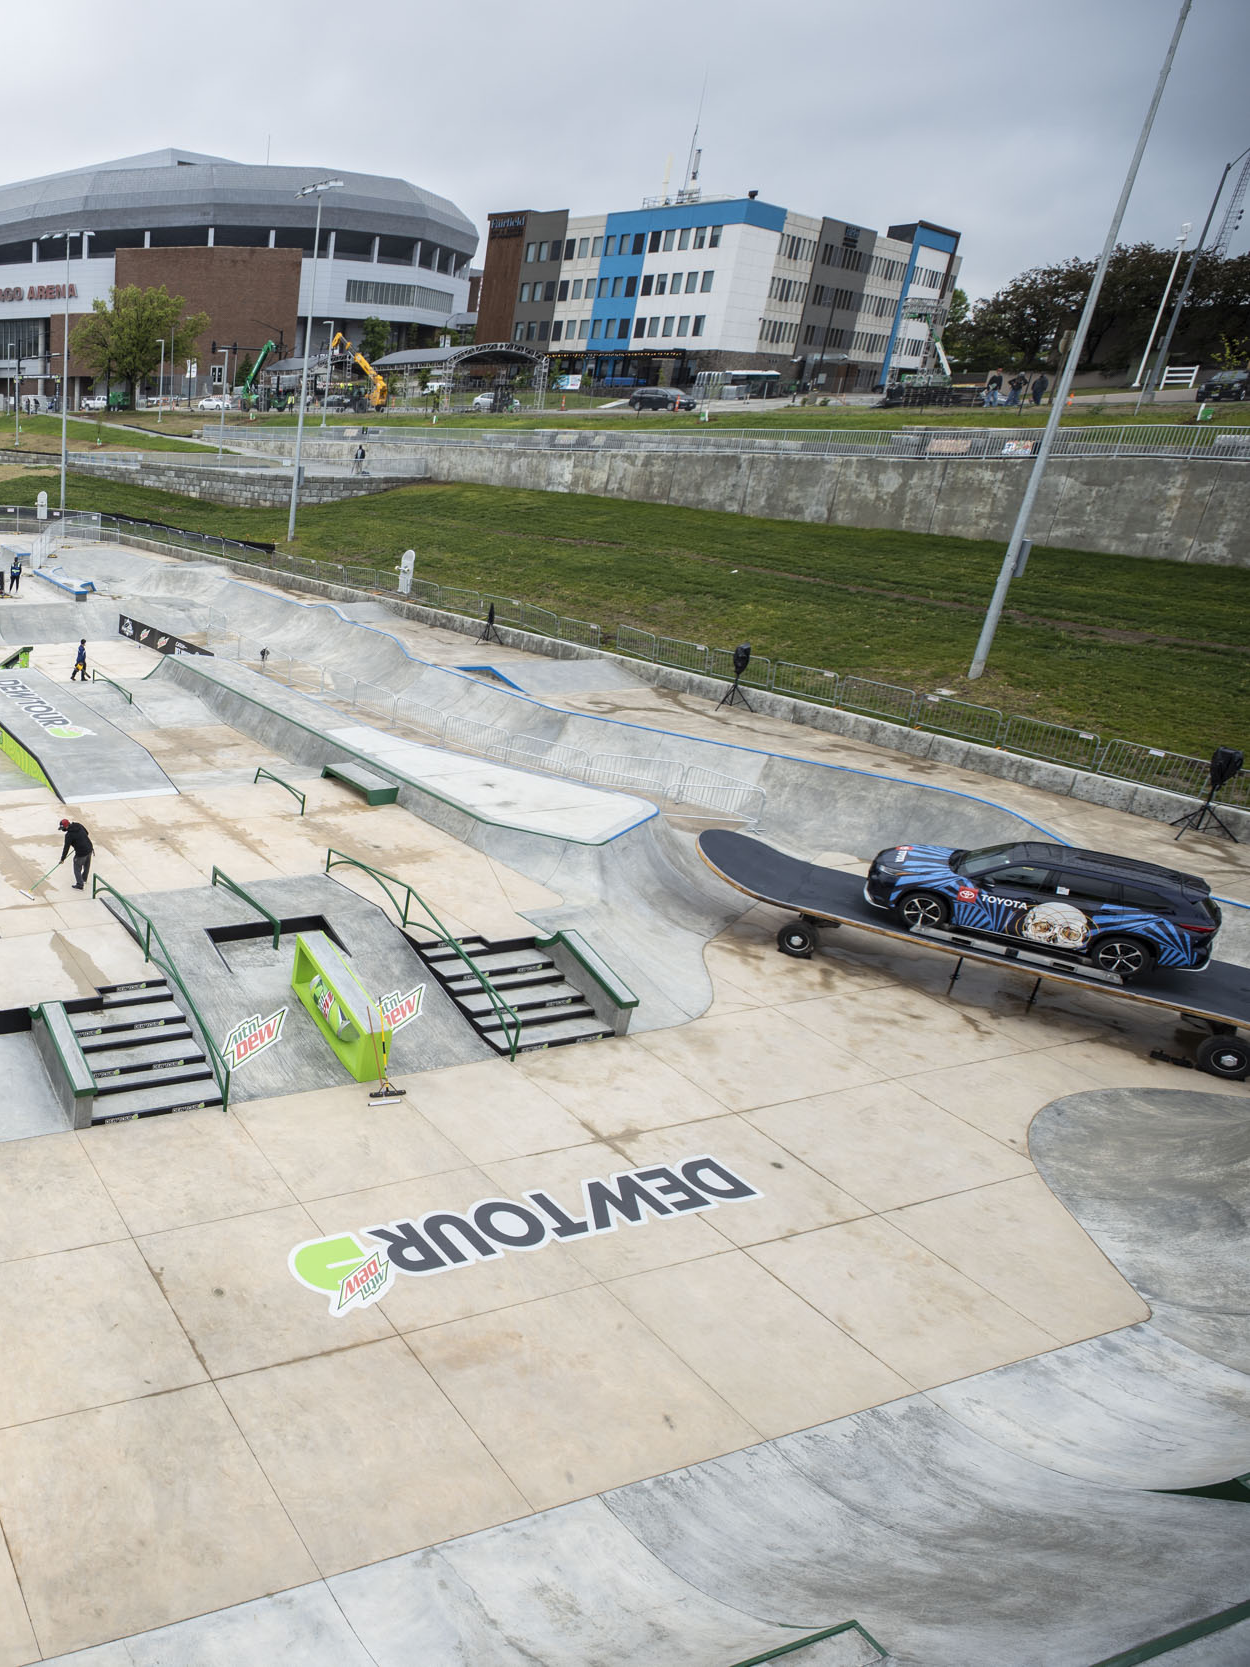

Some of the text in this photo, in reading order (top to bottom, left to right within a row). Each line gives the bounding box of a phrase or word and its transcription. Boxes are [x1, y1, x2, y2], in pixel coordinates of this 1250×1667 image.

[491, 215, 525, 228] Fairfield
[27, 284, 78, 300] ARENA
[980, 893, 1028, 911] TOYOTA
[367, 1157, 760, 1272] DEWTOUR
